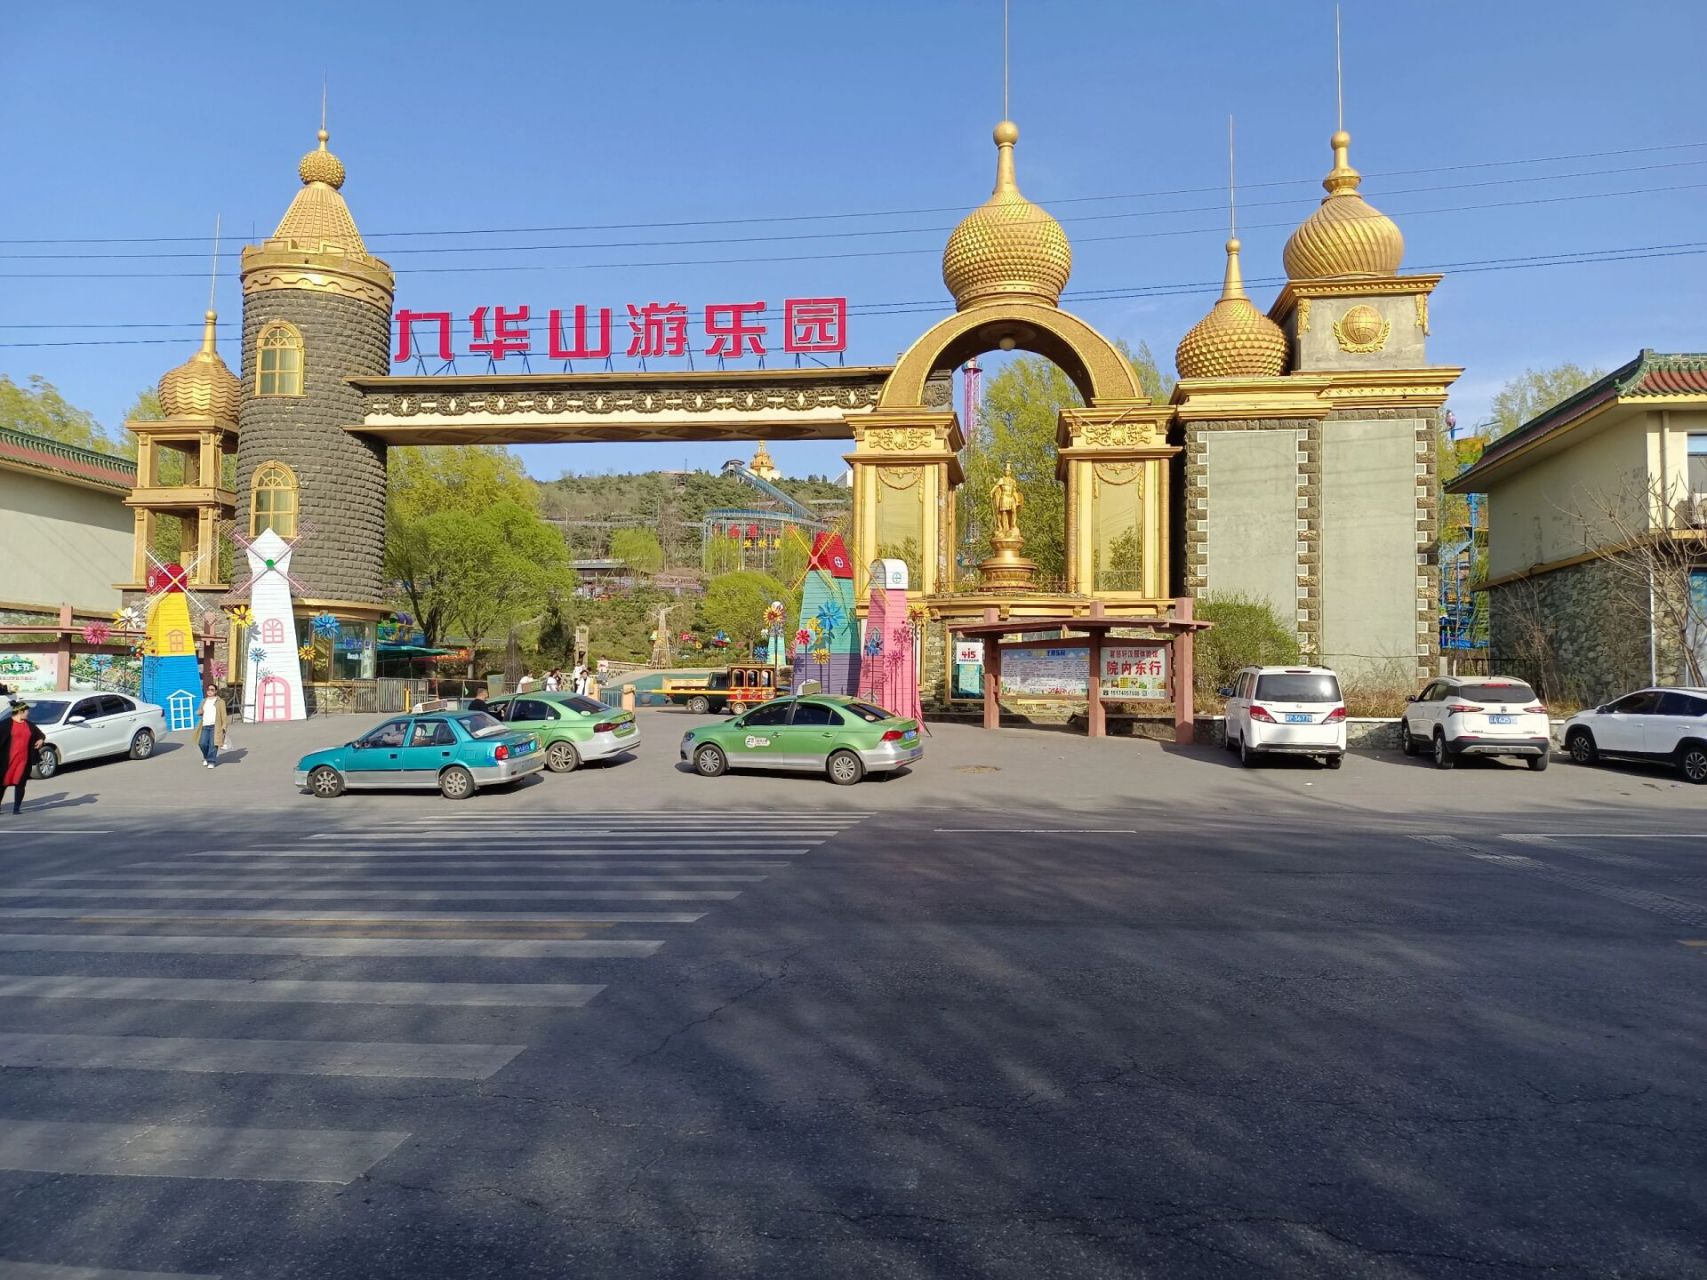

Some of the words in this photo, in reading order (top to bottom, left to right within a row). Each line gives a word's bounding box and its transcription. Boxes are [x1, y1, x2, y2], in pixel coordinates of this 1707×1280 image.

[394, 297, 848, 363] 九华山游乐园
[1106, 660, 1162, 676] 院内东行
